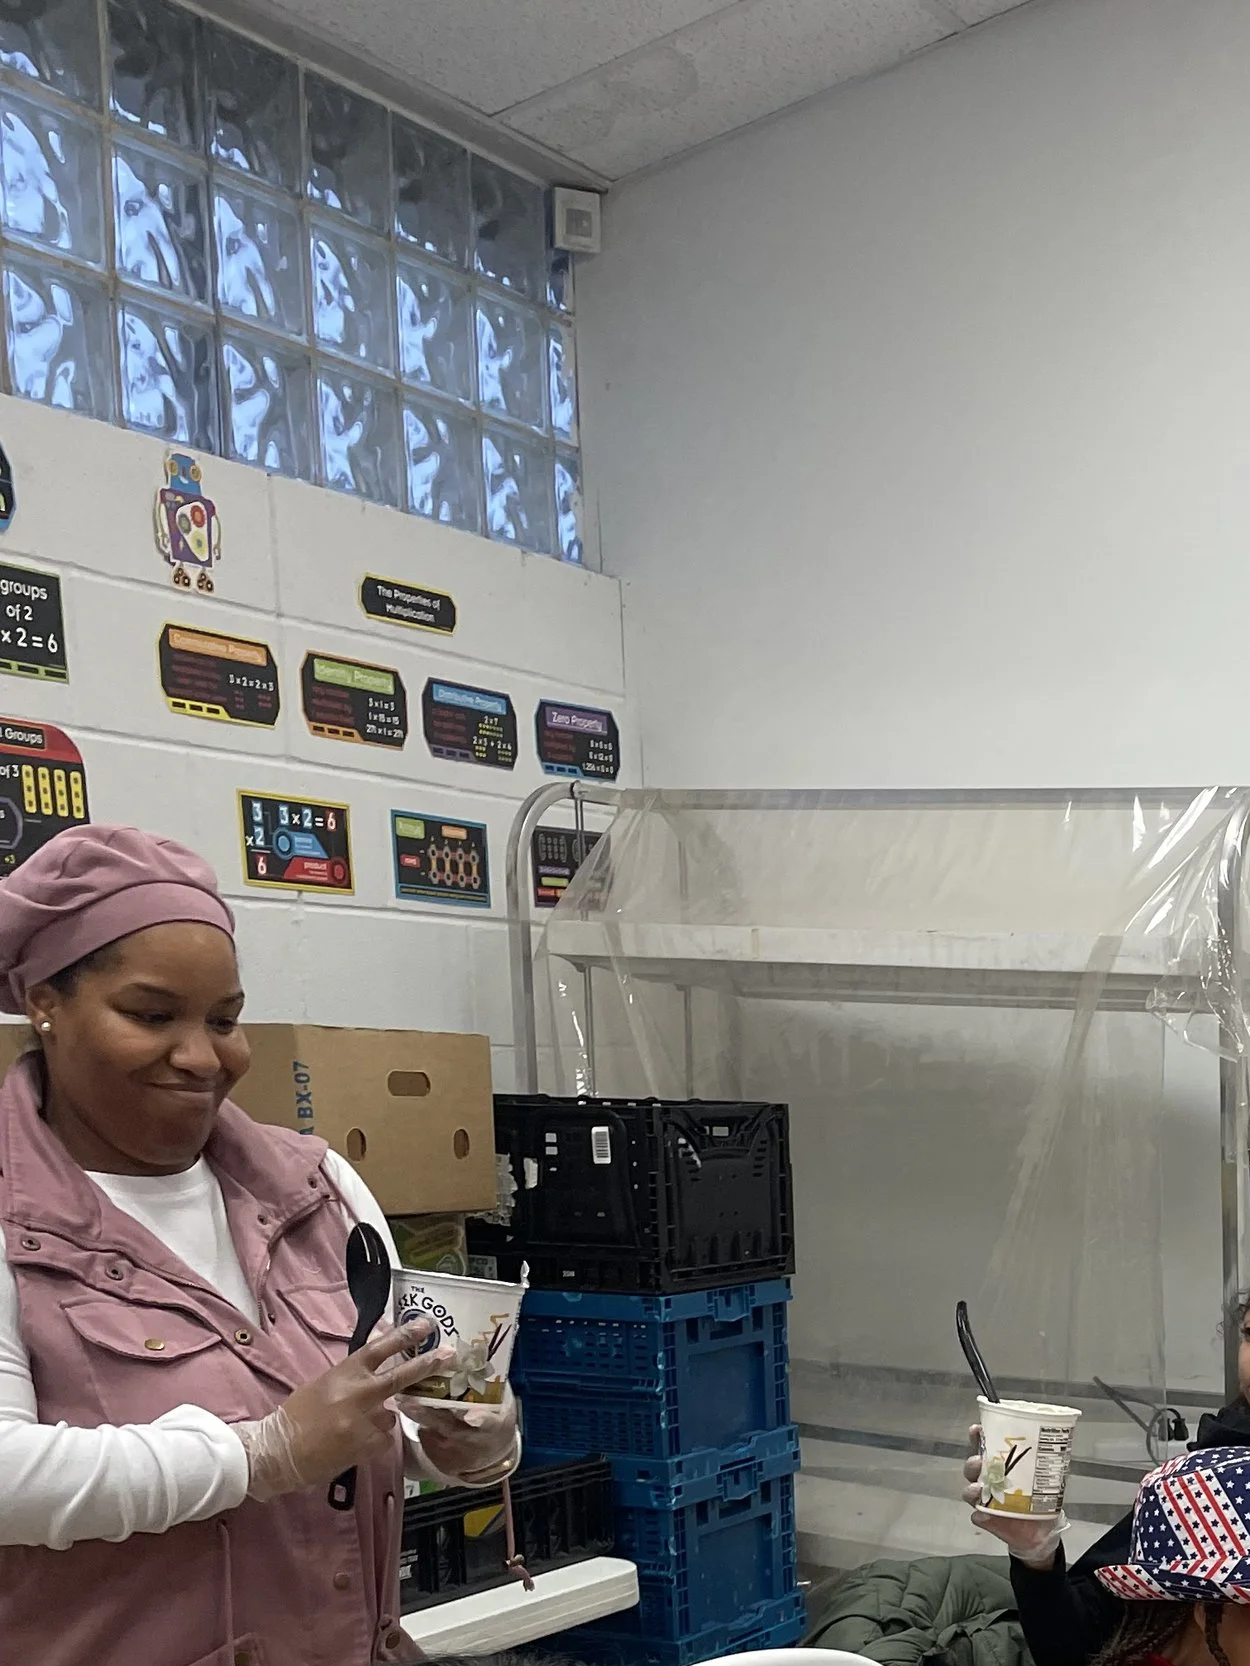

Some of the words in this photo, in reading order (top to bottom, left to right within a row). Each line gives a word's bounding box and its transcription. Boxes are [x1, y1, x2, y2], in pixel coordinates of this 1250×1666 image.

[0, 579, 48, 600] groups
[377, 585, 392, 598] The
[393, 589, 431, 607] Properties
[6, 604, 20, 621] of
[23, 606, 33, 621] 2
[16, 627, 28, 647] 2
[47, 633, 58, 653] 6
[552, 712, 570, 725] Zero
[4, 727, 43, 745] Groups
[12, 764, 20, 778] 3
[253, 802, 262, 821] 3
[280, 806, 289, 825] 3
[303, 808, 313, 828] 2
[327, 812, 336, 830] 6
[254, 826, 265, 846] 2
[257, 856, 267, 875] 6
[421, 1296, 460, 1338] GODS
